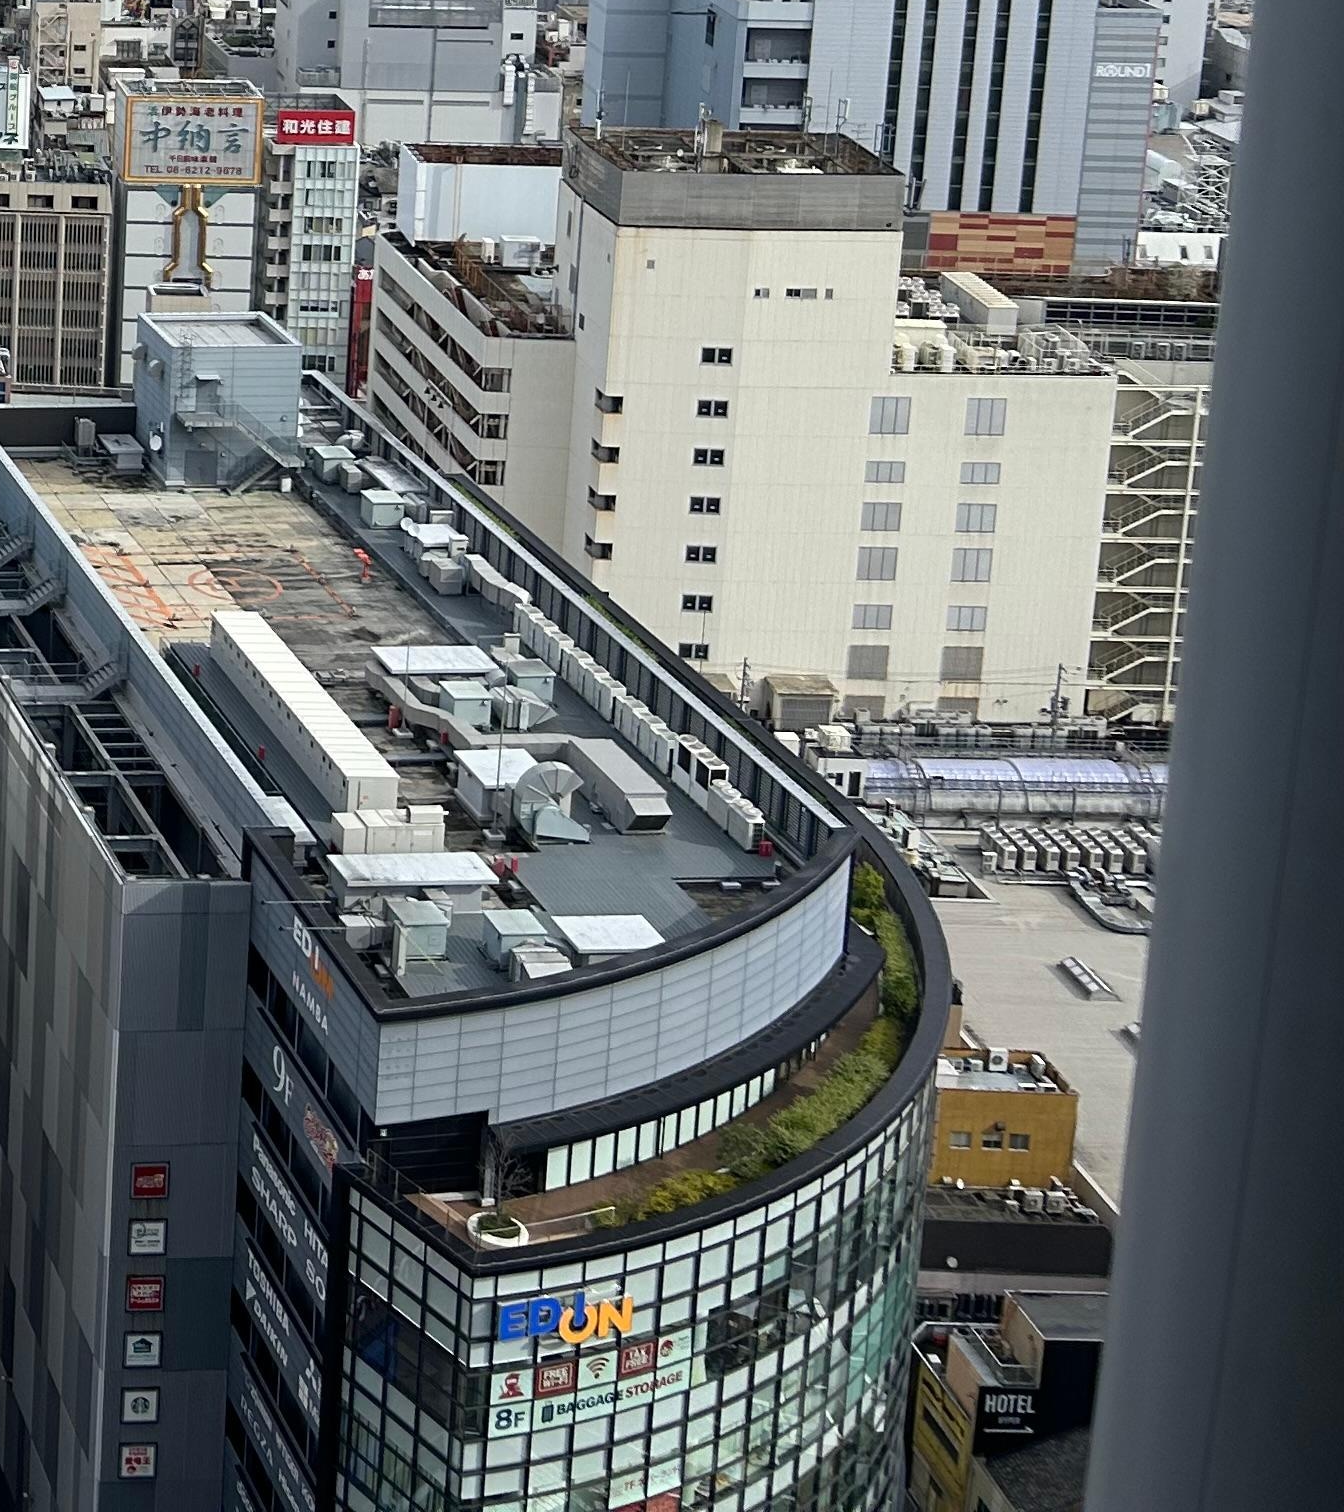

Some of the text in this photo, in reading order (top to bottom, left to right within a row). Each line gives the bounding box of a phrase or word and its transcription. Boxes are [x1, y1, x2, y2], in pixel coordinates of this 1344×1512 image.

[139, 119, 250, 154] 中納言
[282, 119, 351, 135] 和光住建
[143, 164, 164, 174] TEL
[291, 970, 329, 1036] NAMBA
[272, 1045, 294, 1107] 9F
[252, 1132, 297, 1217] Panasonic
[251, 1165, 298, 1248] SHARP
[247, 1246, 290, 1337] TOSHIBA
[253, 1299, 288, 1368] DAIKIN
[497, 1290, 634, 1344] EDION
[543, 1365, 569, 1379] FREE
[556, 1370, 683, 1415] BAGGAGE STORAGE
[494, 1409, 526, 1430] 8F
[984, 1394, 1036, 1414] HOTEL
